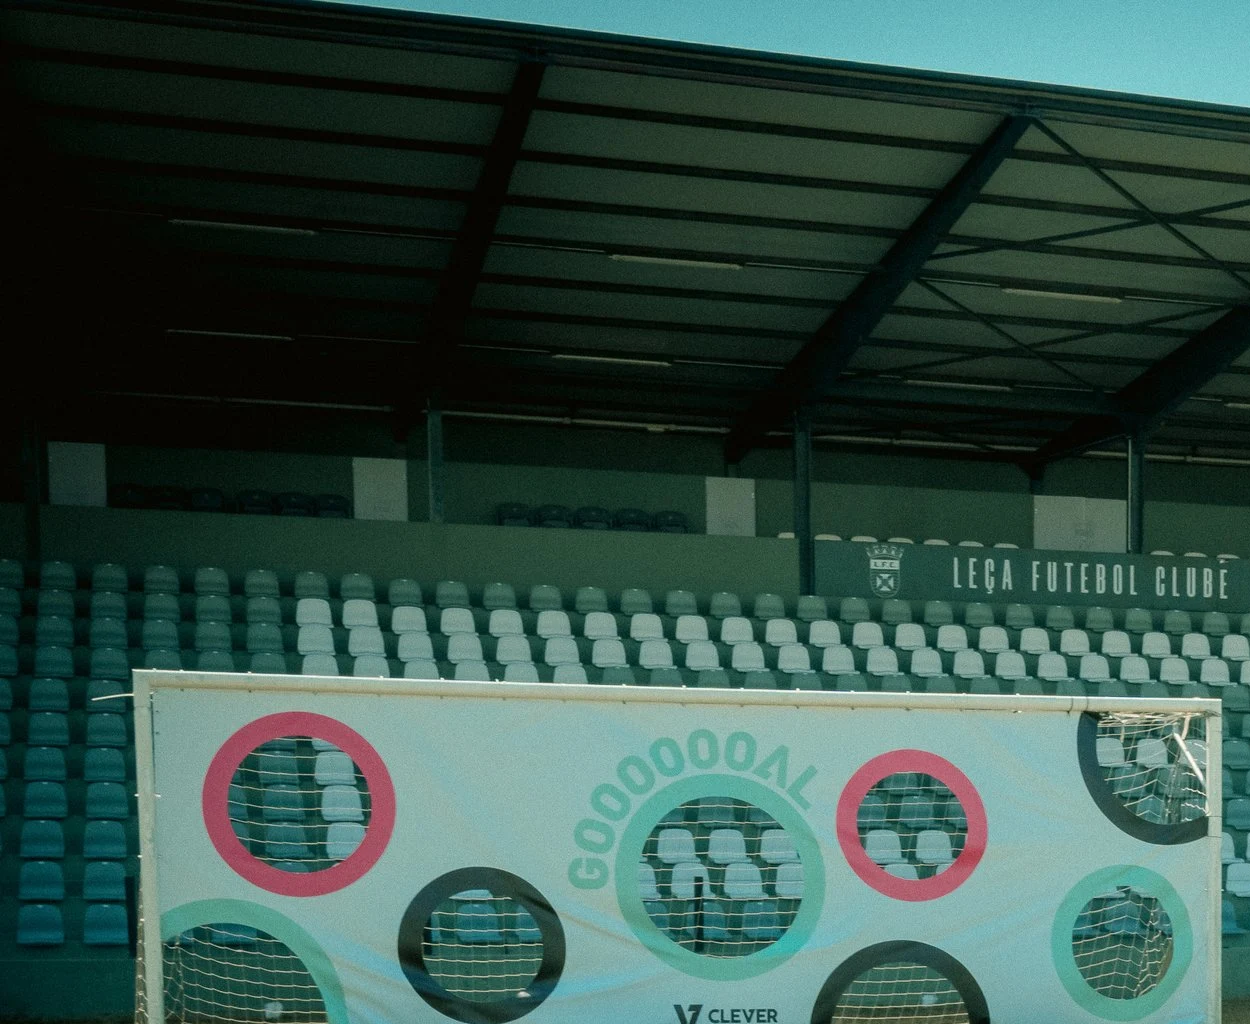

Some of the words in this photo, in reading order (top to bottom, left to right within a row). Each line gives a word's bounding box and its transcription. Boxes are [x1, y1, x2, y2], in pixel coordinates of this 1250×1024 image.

[952, 557, 1013, 594] LEÇA
[1031, 560, 1137, 596] FUTEBOL
[1155, 566, 1229, 600] CLUBE
[567, 728, 818, 890] GOOOOOOAL
[708, 1008, 778, 1023] CLEVER
